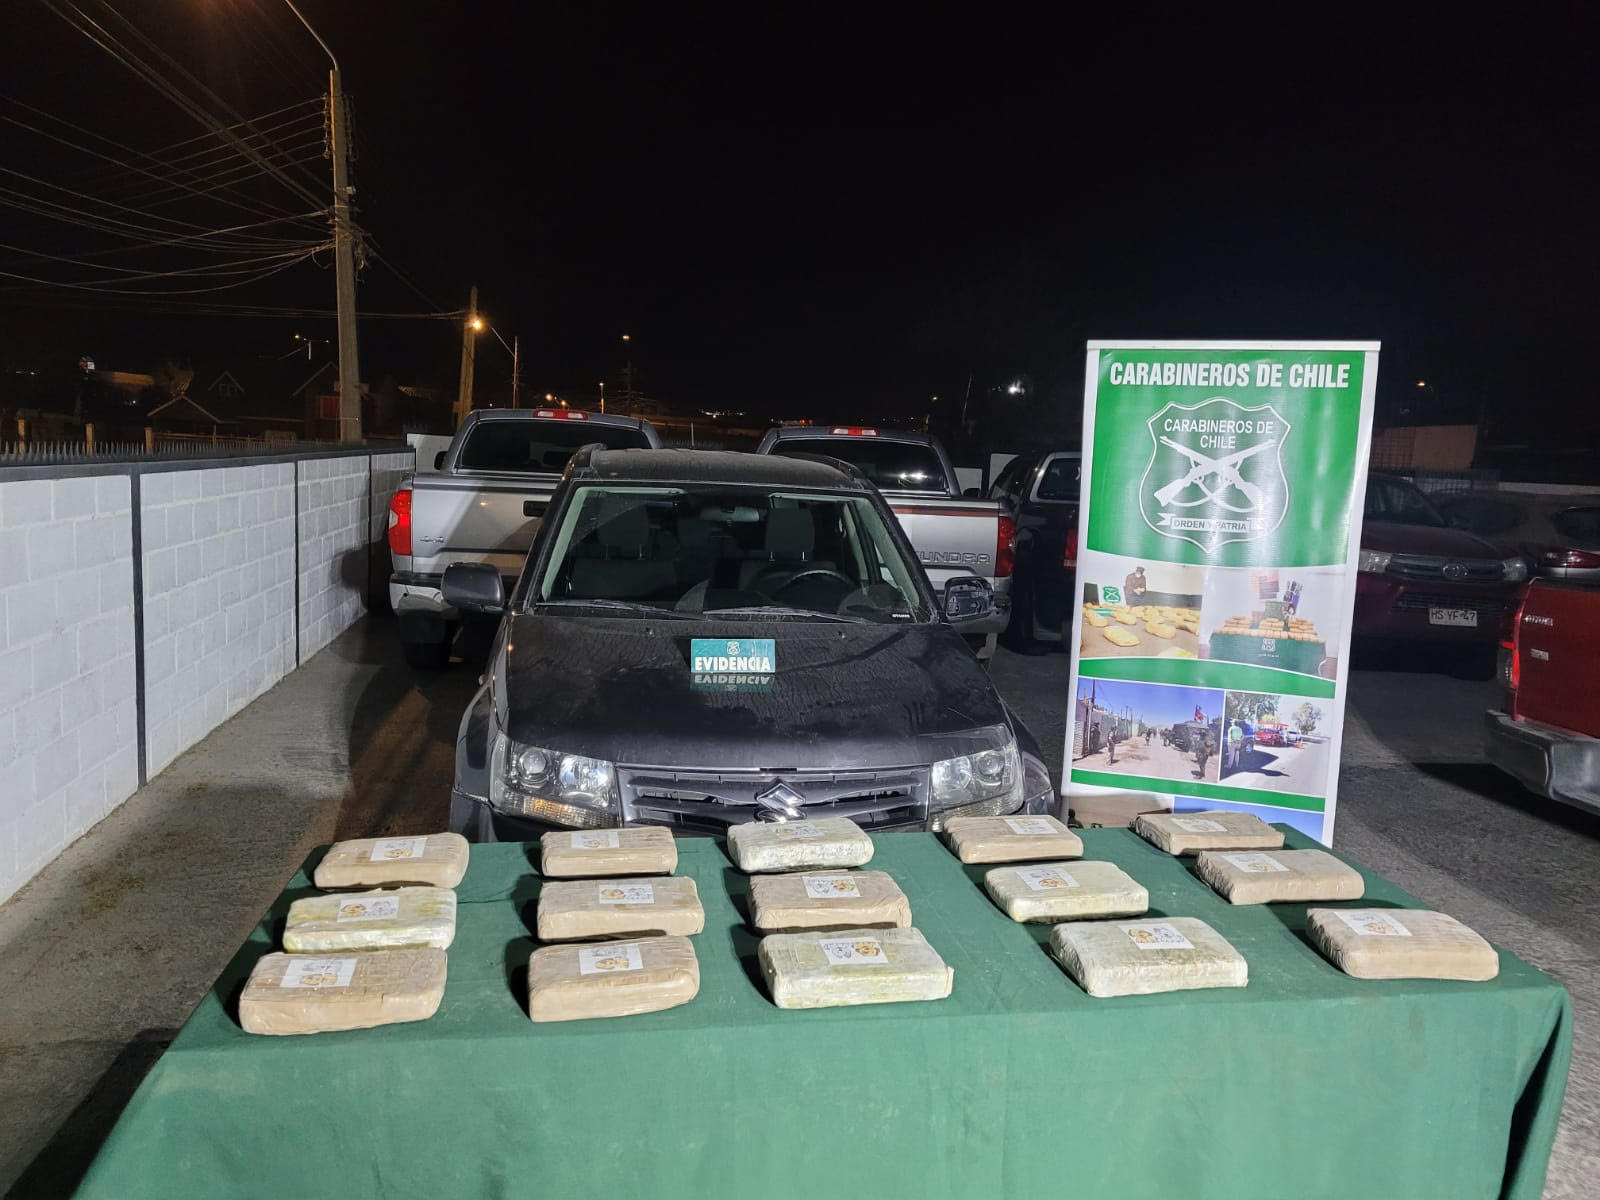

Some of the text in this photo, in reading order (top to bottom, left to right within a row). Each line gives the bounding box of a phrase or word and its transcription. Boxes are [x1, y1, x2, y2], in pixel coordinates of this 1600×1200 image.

[1110, 362, 1350, 388] CARABINEROS DE CHILE
[1164, 418, 1274, 434] CARABINEROS DE
[1200, 435, 1237, 449] CHILE
[1173, 519, 1205, 529] ORDEN
[694, 656, 772, 671] EVIDENCIA
